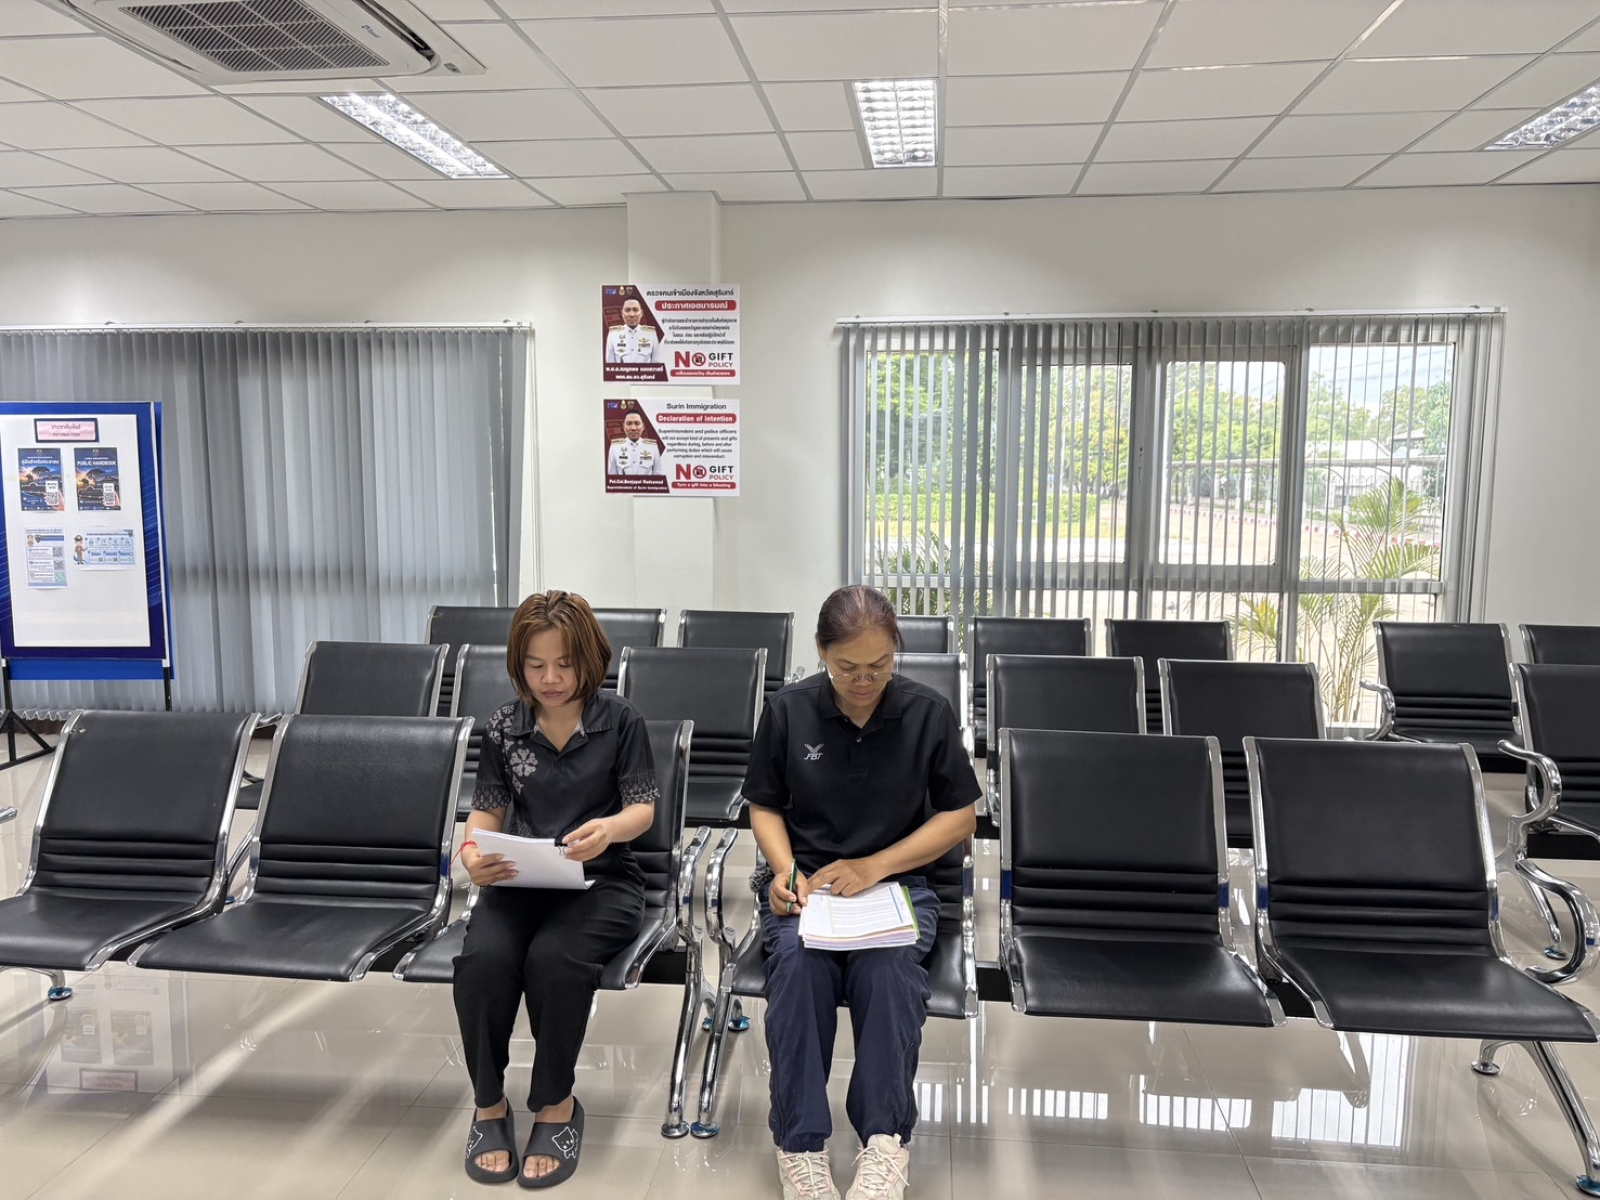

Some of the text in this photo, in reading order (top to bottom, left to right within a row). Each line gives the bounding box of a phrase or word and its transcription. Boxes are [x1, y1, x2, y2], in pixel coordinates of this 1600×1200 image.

[647, 289, 734, 297] ตรวจคนเข้าเมืองจังหวัดสุรินทร์
[662, 301, 728, 309] ประกาศเจตนารมณ์
[708, 353, 733, 361] GIFT
[686, 403, 726, 411] Immigration
